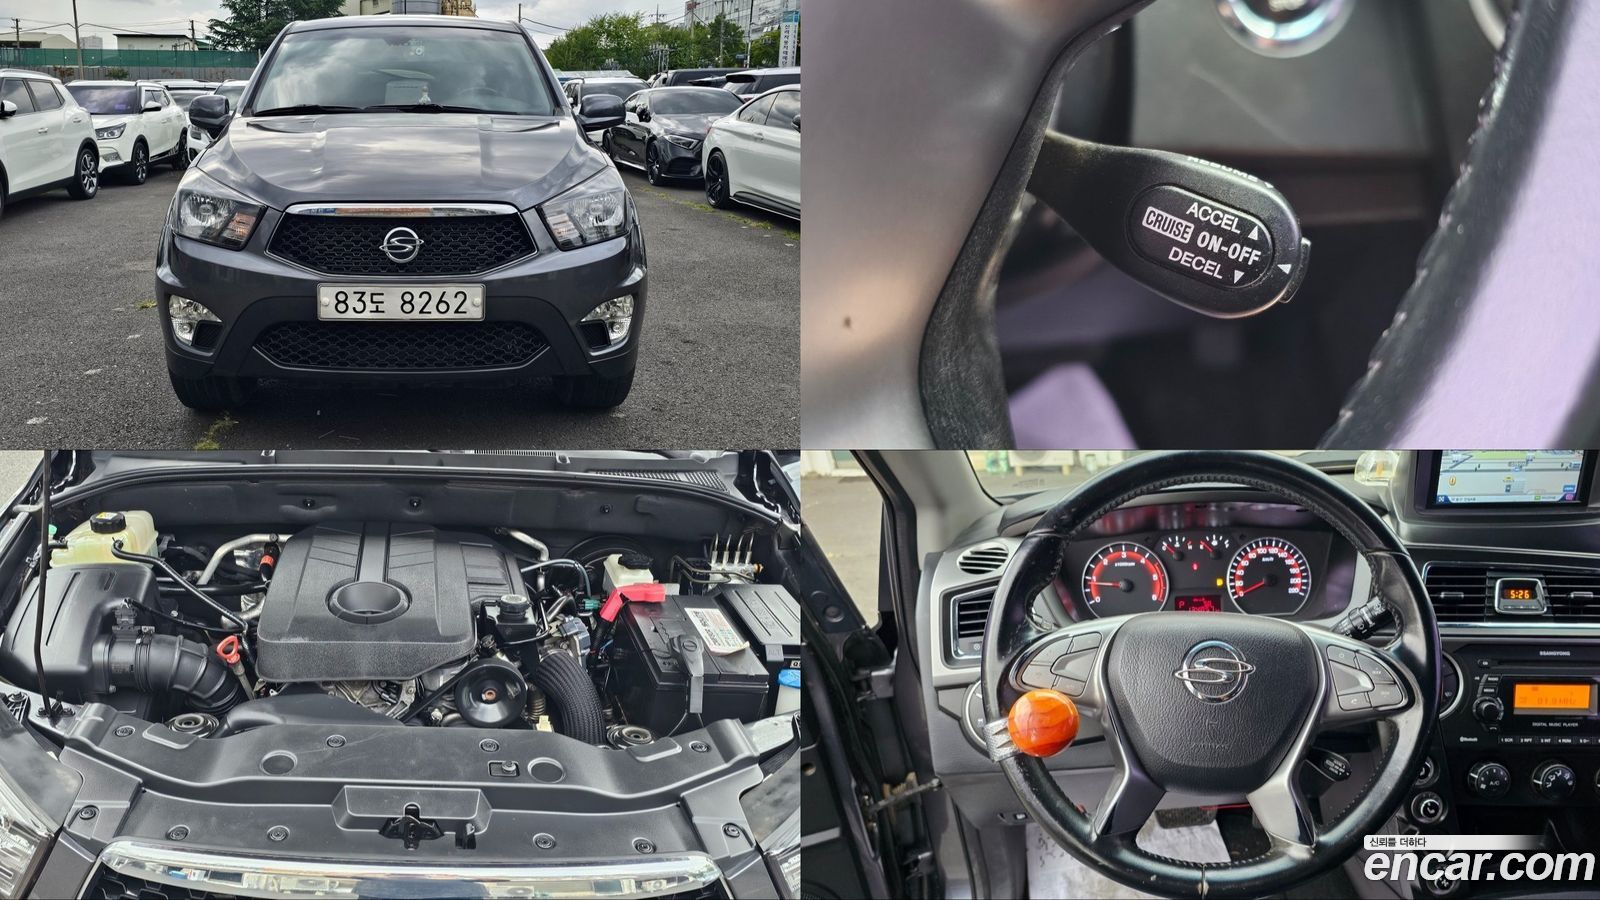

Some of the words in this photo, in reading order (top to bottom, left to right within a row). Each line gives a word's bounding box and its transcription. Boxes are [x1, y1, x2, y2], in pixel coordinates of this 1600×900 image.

[1186, 202, 1241, 234] ACCEL
[1144, 208, 1193, 242] CRUISE
[1197, 231, 1261, 265] ON-OFF
[1168, 246, 1223, 279] DECEL
[334, 290, 385, 314] 83도
[400, 290, 467, 314] 8262
[1510, 590, 1530, 599] 5:26
